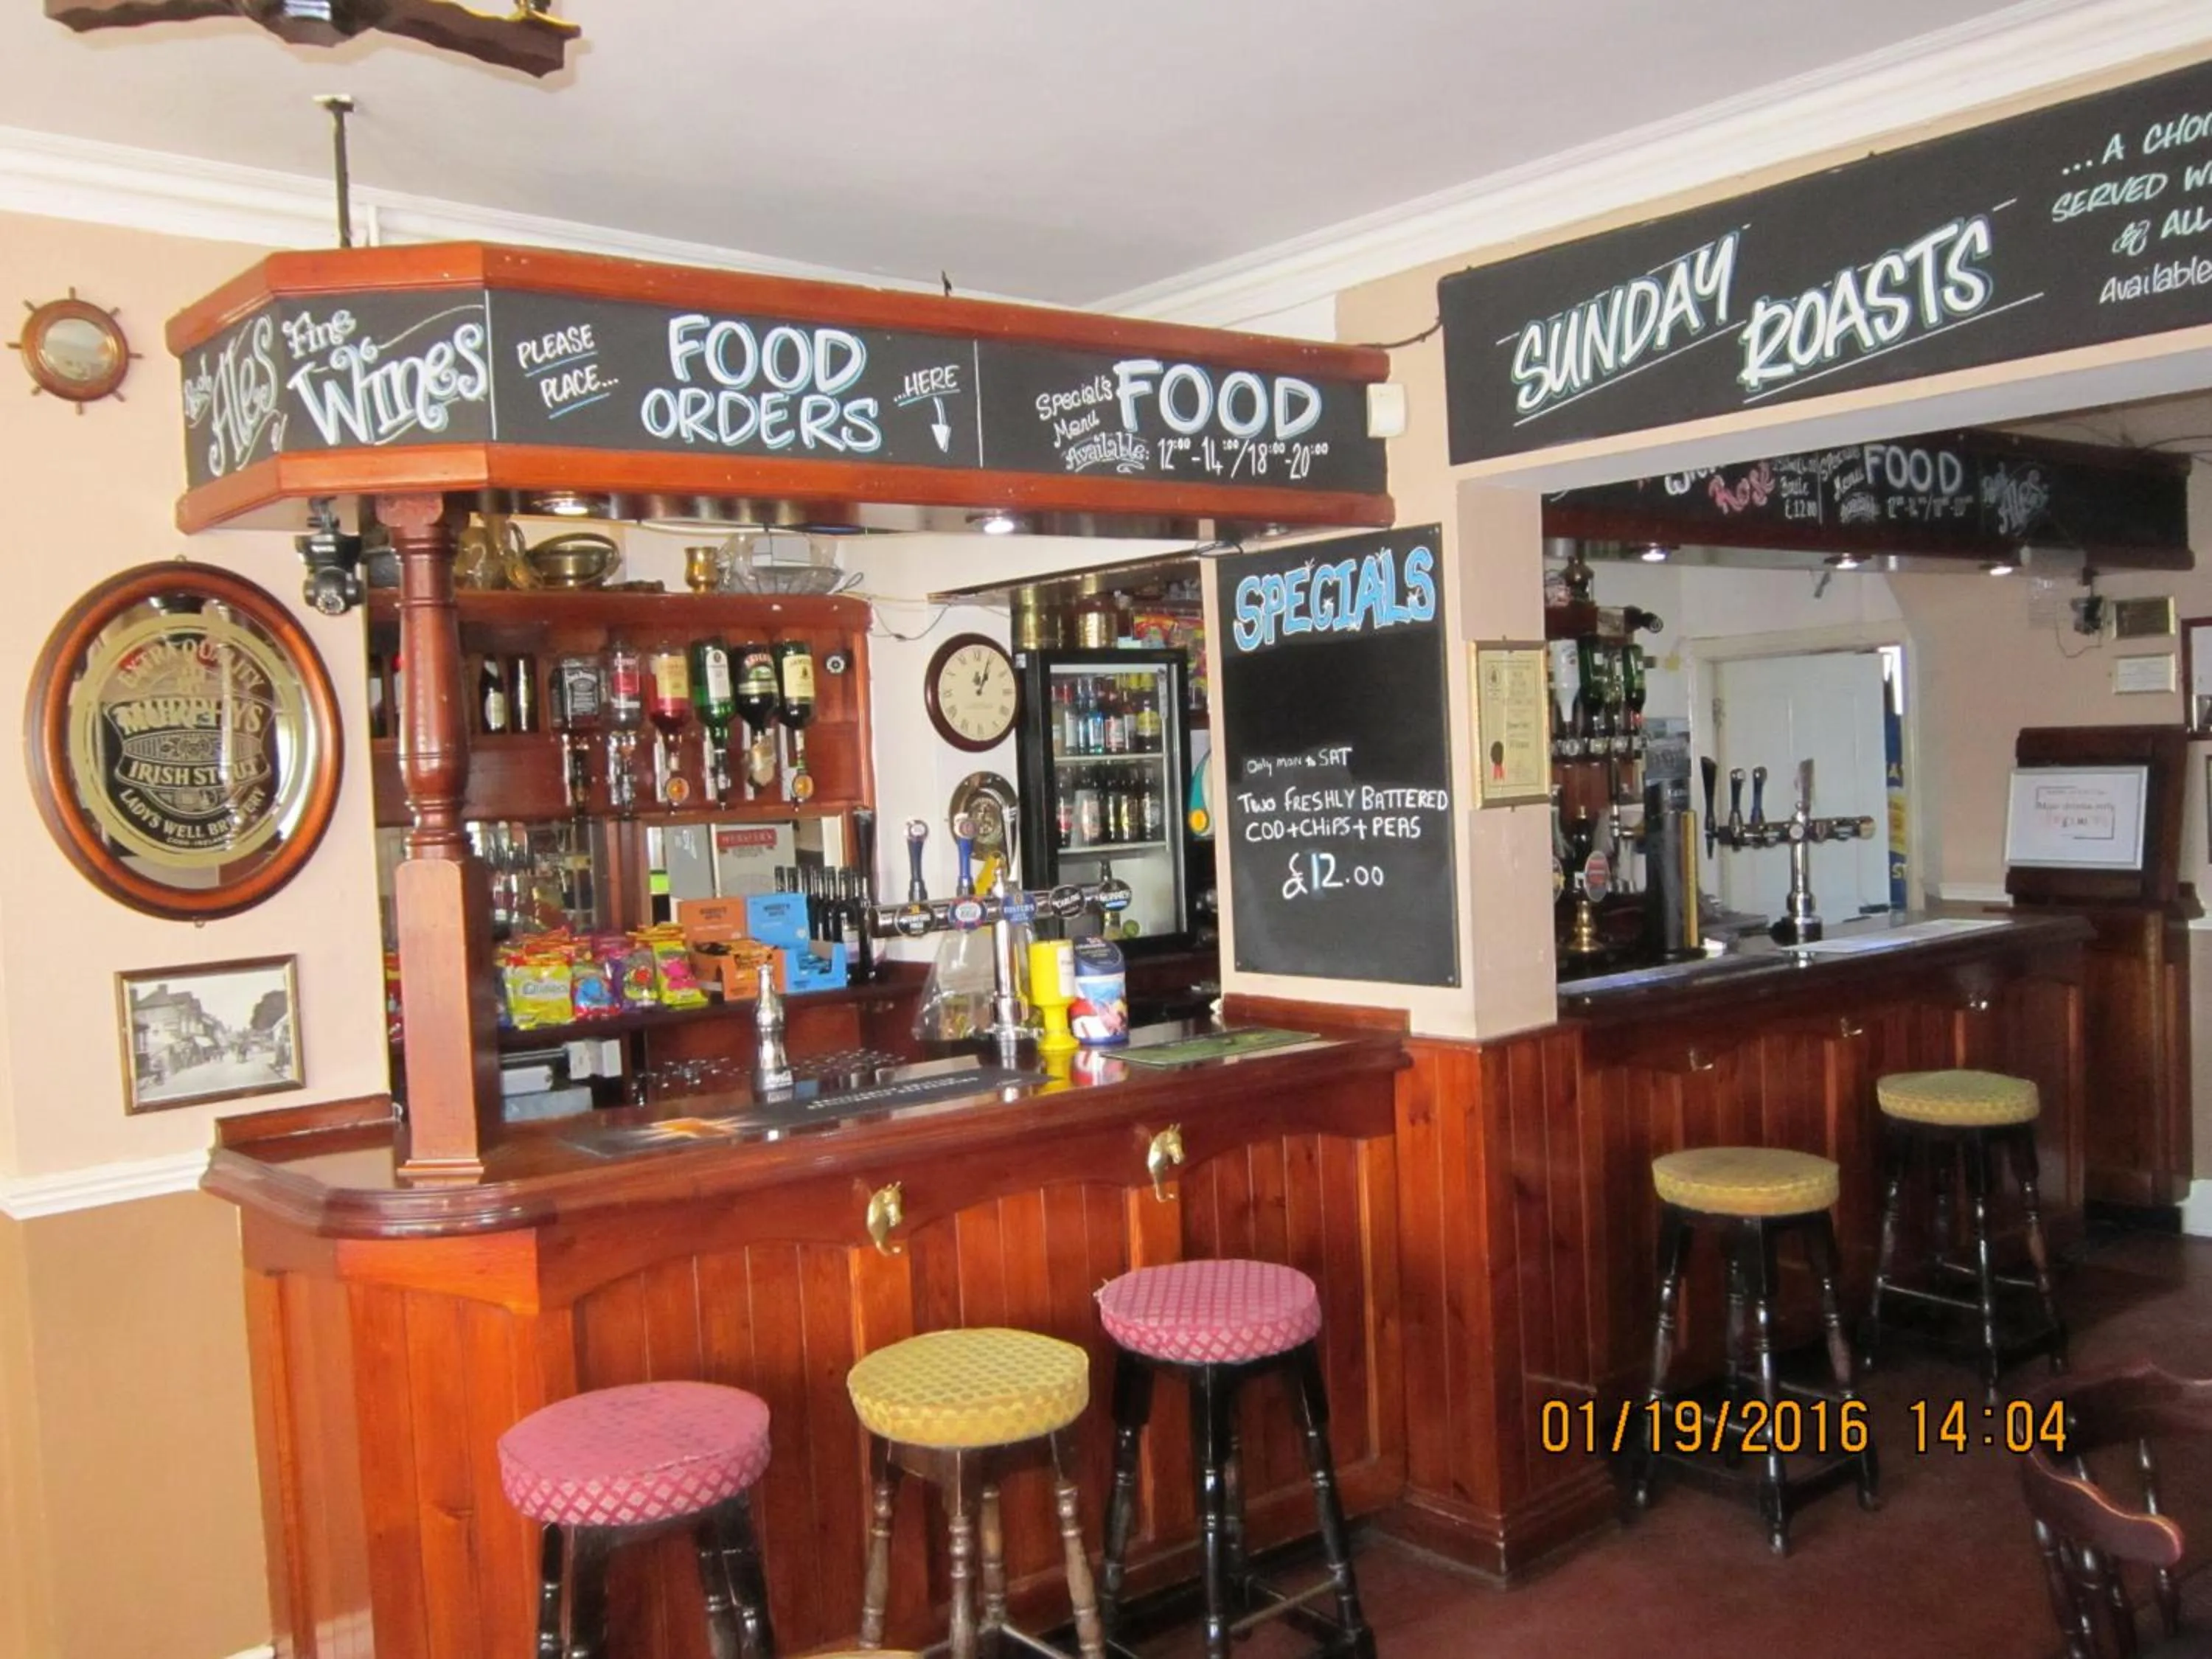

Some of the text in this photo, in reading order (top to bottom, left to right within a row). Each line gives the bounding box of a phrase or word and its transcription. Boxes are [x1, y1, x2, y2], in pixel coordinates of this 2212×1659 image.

[2052, 173, 2168, 223] SERVED
[1737, 215, 1992, 391] ROASTS
[2098, 255, 2212, 305] Available
[282, 309, 357, 360] Fine
[516, 324, 596, 369] PLEASE
[1512, 230, 1740, 413] SUNDAY
[669, 313, 868, 396] FOOD
[286, 322, 490, 446] Wines
[1113, 358, 1322, 441] FOOD
[641, 387, 883, 452] ORDERS
[1052, 408, 1102, 449] Menu
[1864, 444, 1963, 496] FOOD
[1233, 546, 1436, 652] SPECIALS
[181, 638, 265, 692] QUAITY
[128, 759, 258, 786] IRISH STUT
[1318, 746, 1353, 767] SAT
[163, 819, 206, 838] WELL
[207, 786, 266, 836] BRERY
[1284, 785, 1356, 813] FRESHLY
[1361, 785, 1449, 811] BATTERED
[1371, 815, 1422, 839] PEAS
[1281, 852, 1385, 900] £12.00
